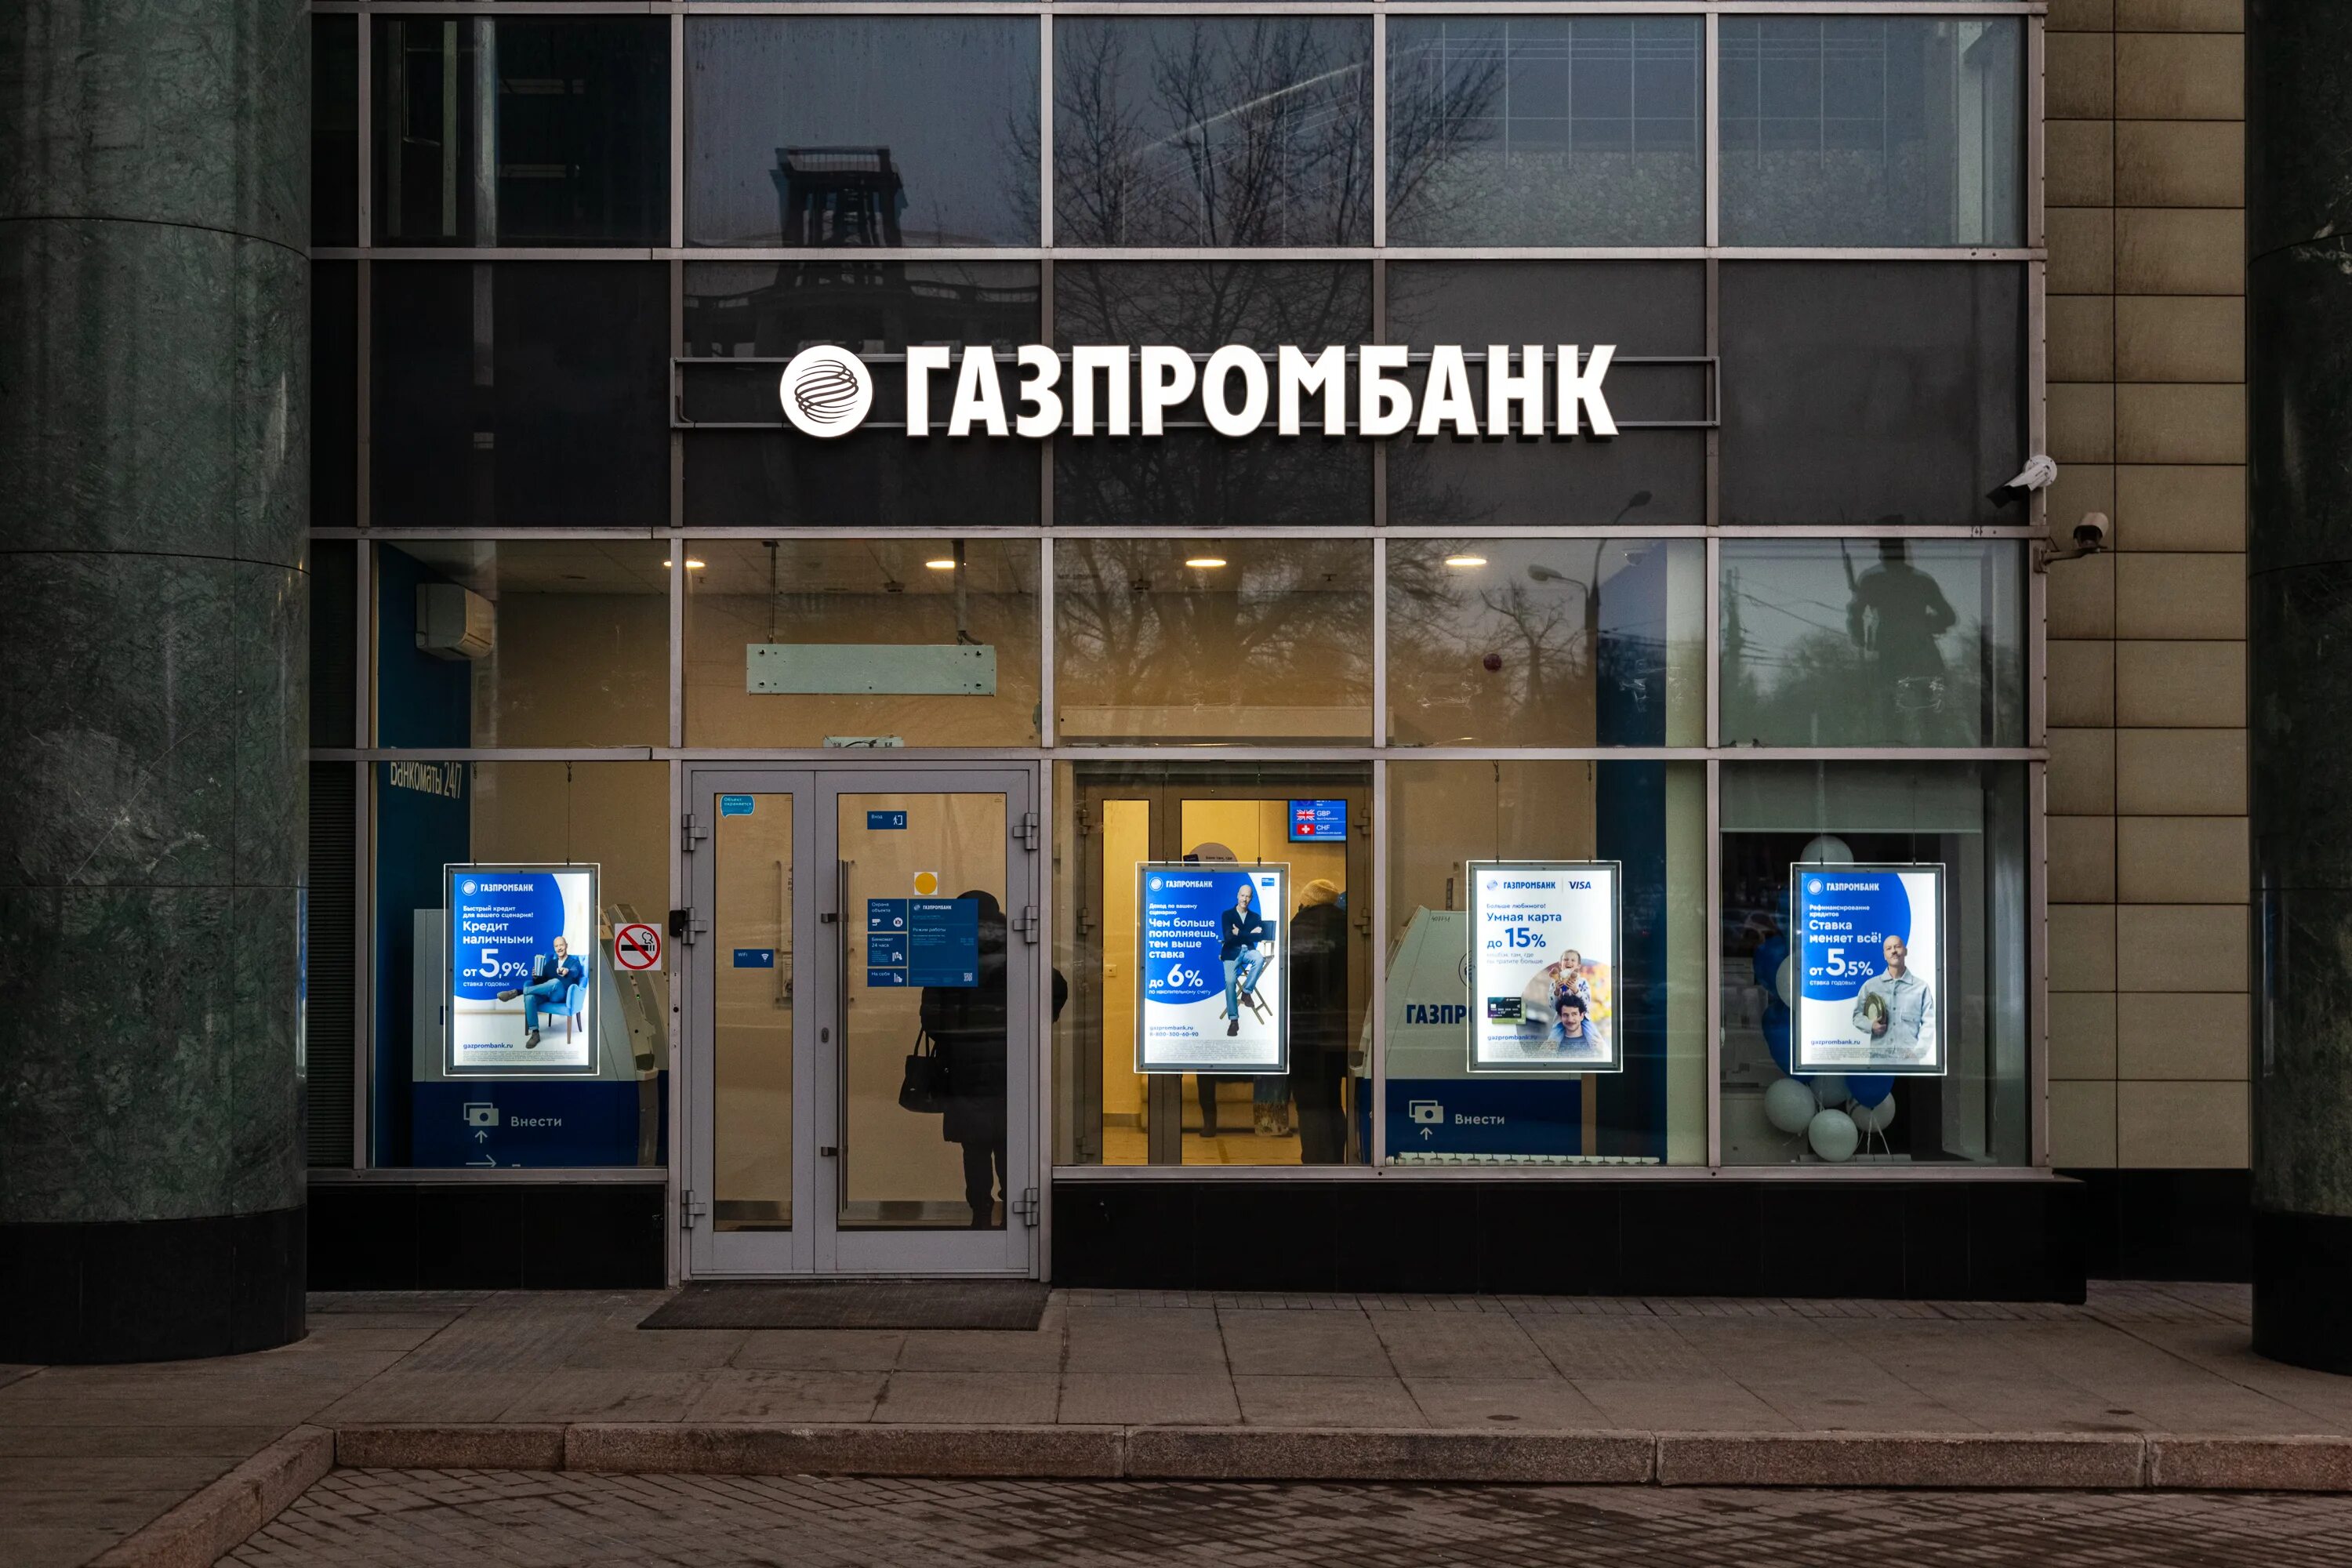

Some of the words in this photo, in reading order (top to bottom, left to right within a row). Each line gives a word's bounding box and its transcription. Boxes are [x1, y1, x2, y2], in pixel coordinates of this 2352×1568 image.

[906, 343, 1619, 437] ГАЗПРОМБАНК
[481, 884, 534, 892] ГАЗПРОМБАНК
[1826, 883, 1880, 891] ГАЗПРОМБАНК
[1149, 918, 1171, 927] Чем
[1174, 917, 1215, 927] больше
[1486, 913, 1524, 922] Умная
[1528, 913, 1562, 924] карта
[463, 921, 509, 933] Кредит
[1809, 920, 1853, 931] Ставка
[463, 935, 533, 944] наличными
[1149, 931, 1219, 939] пополняешь,
[1486, 940, 1503, 949] до
[1504, 927, 1546, 948] 15%
[1809, 934, 1853, 943] меняет
[1857, 931, 1882, 943] всё!
[463, 968, 477, 977] от
[479, 949, 528, 978] 5,9%
[1809, 967, 1824, 976] от
[1825, 948, 1874, 978] 5,5%
[1149, 979, 1163, 988] до
[1167, 964, 1203, 987] 6%
[510, 1116, 562, 1127] Внести
[1455, 1113, 1505, 1125] Внести
